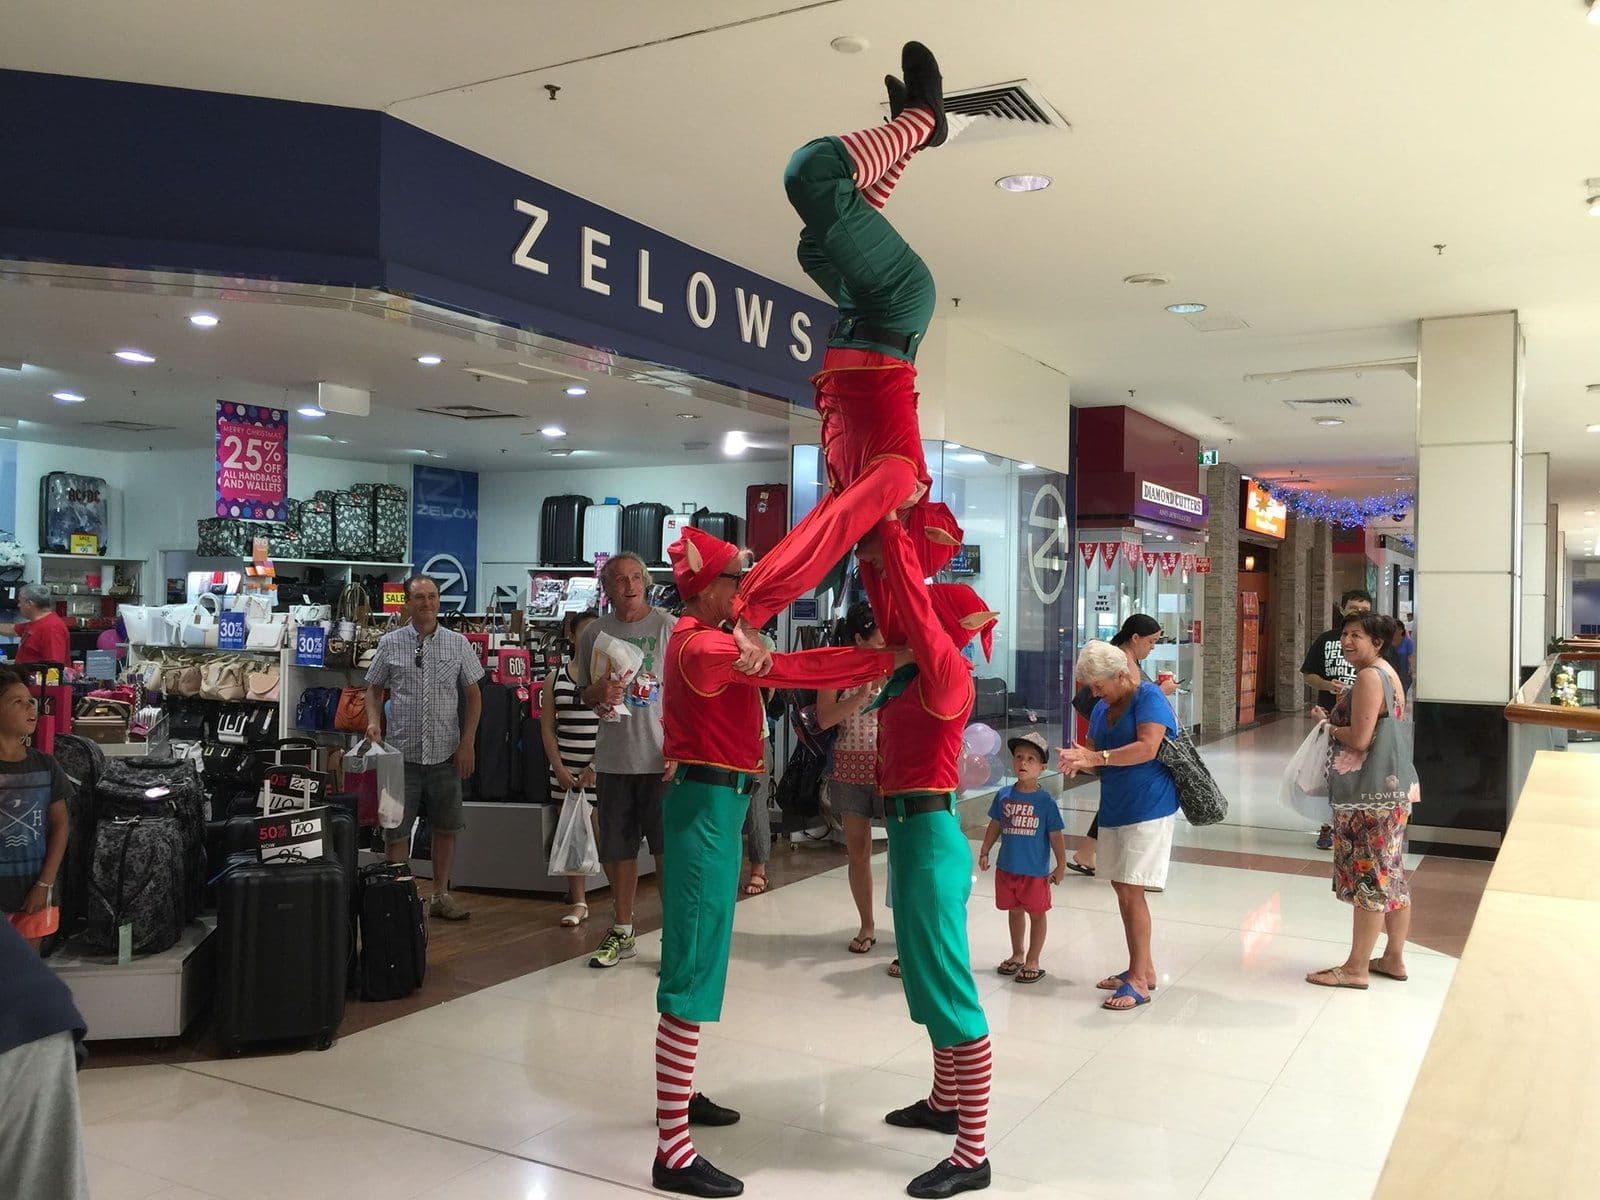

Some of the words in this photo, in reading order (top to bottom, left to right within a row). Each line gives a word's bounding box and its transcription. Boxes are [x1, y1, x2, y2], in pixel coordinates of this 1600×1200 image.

[512, 198, 813, 363] ZELOWS
[223, 425, 244, 434] MERRY
[246, 428, 282, 439] CHRISTMAS
[223, 435, 281, 471] 25%
[264, 463, 281, 474] OFF
[223, 470, 237, 479] ALL
[239, 471, 282, 484] HANDBAGS
[223, 480, 244, 489] AND
[246, 481, 282, 493] WALLETS
[1144, 484, 1175, 505] DIAMOND
[1175, 494, 1201, 512] CUTTERS
[385, 592, 405, 603] SALE
[220, 622, 243, 637] 30%
[299, 637, 322, 653] 30%
[1361, 791, 1406, 801] FLOWER
[1012, 815, 1040, 828] HERO
[259, 824, 287, 840] 50%
